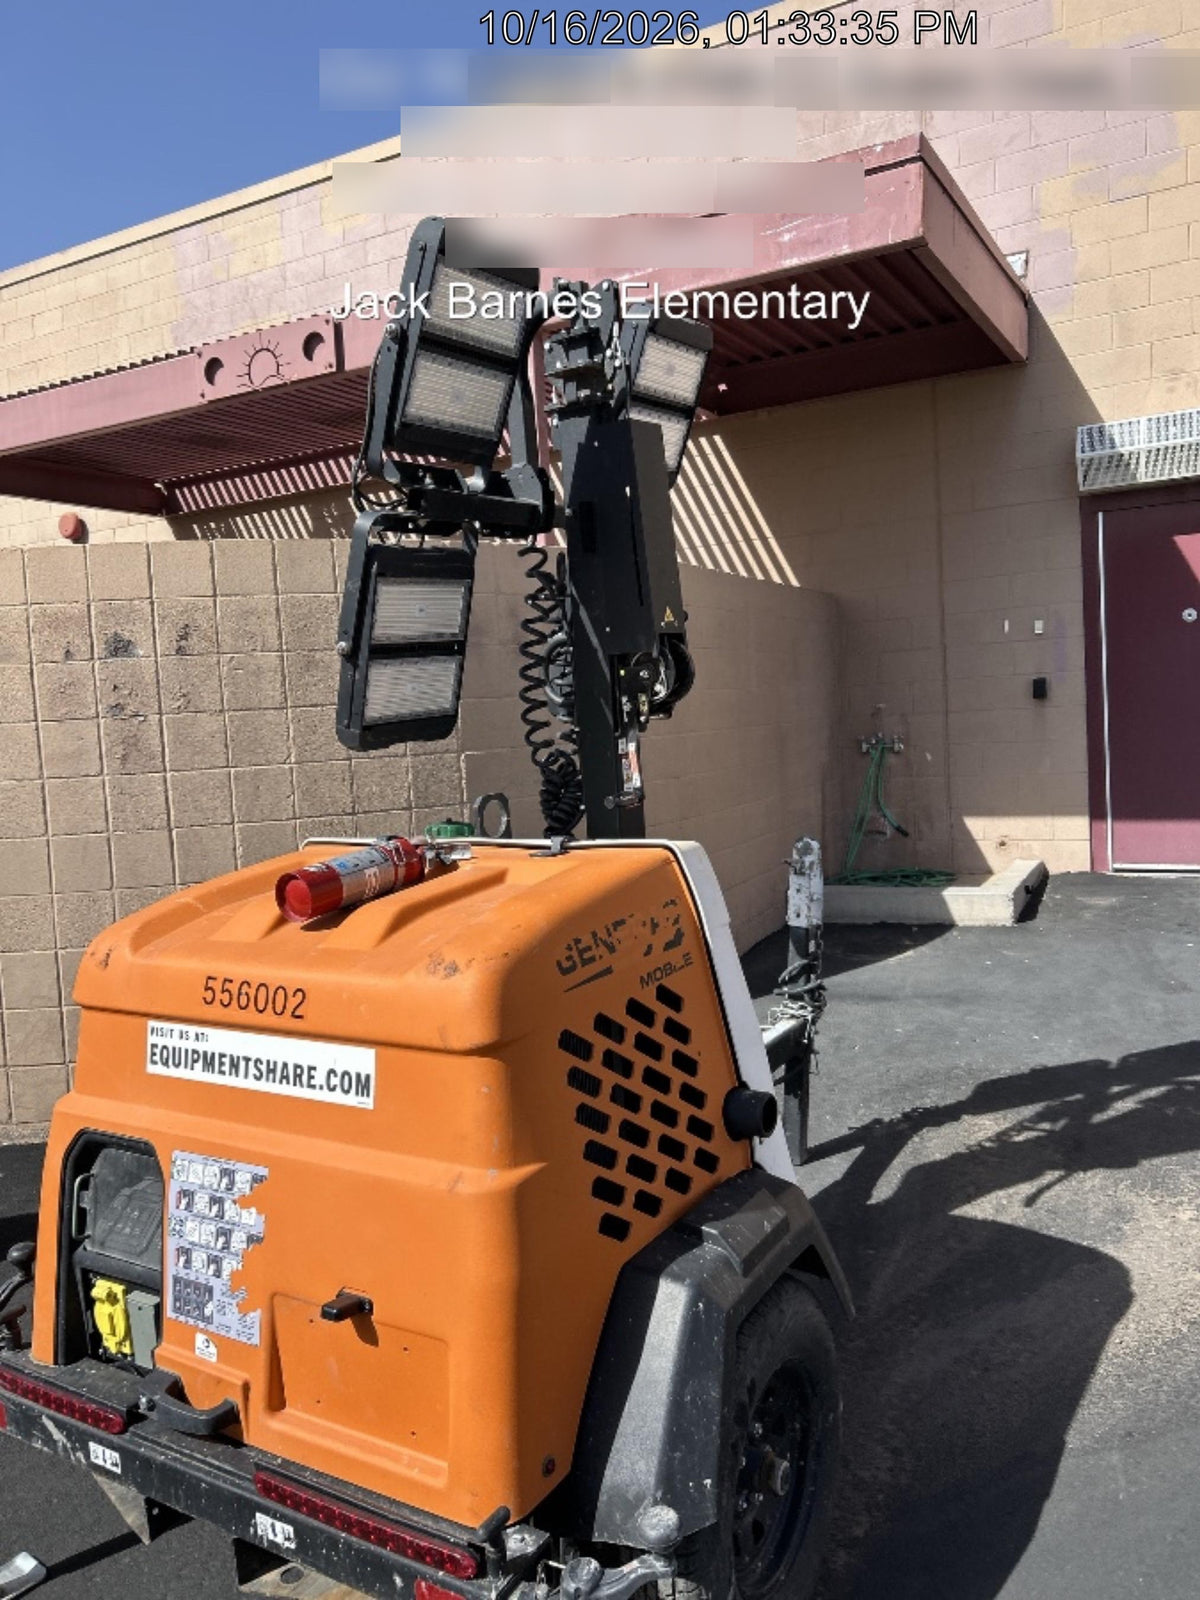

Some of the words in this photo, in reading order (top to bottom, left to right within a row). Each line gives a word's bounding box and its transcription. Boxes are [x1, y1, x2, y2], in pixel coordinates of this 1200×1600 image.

[202, 975, 307, 1020] 556002
[150, 1026, 175, 1039] VISIT
[150, 1042, 372, 1099] EQUIPMENTSHARE.COM
